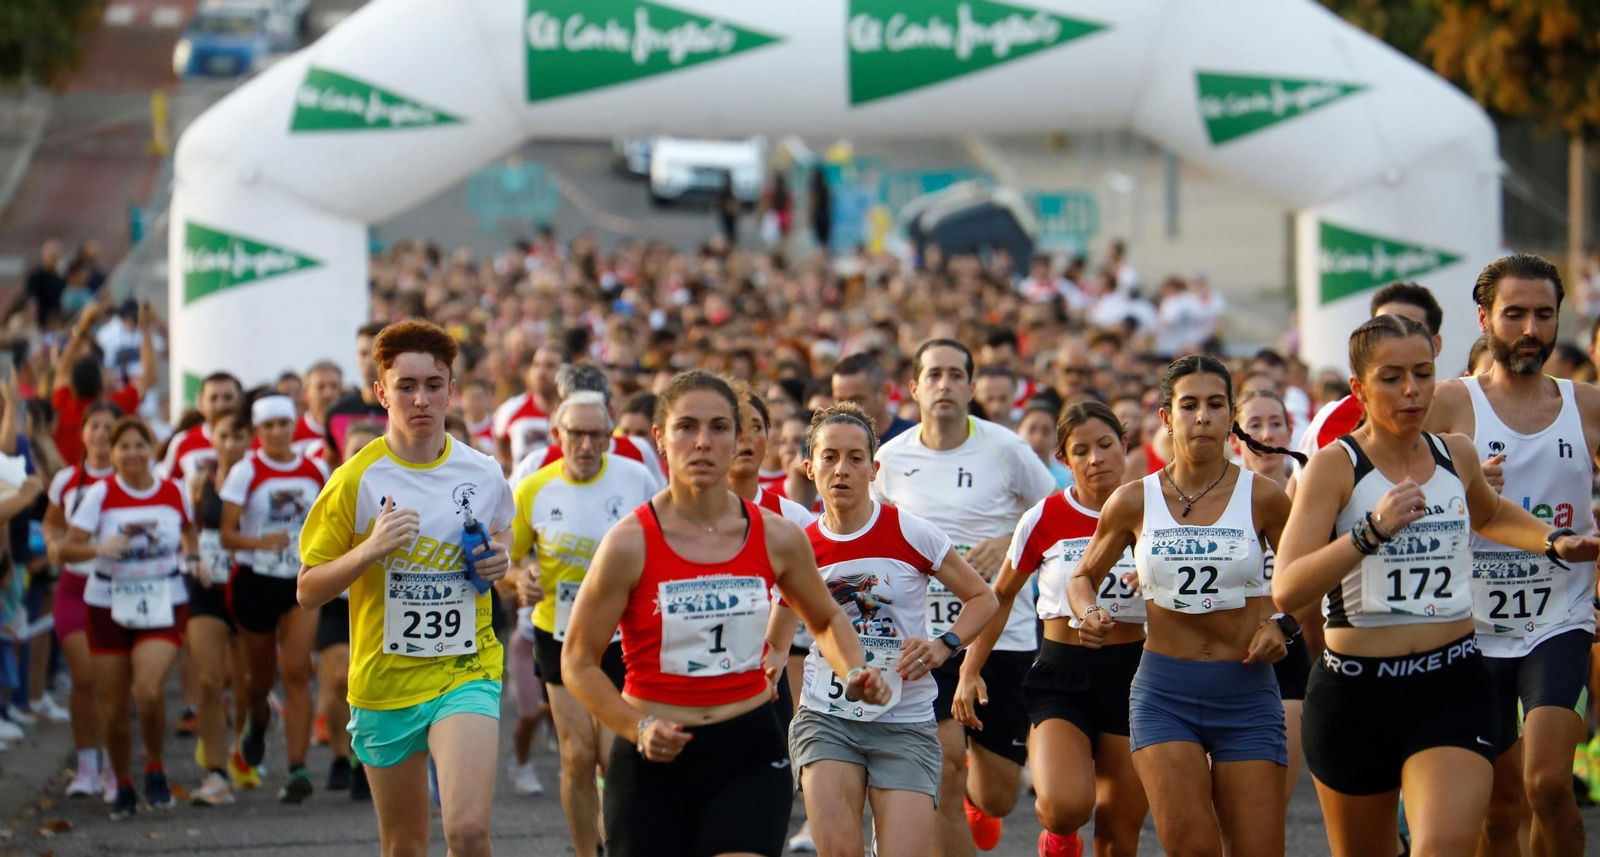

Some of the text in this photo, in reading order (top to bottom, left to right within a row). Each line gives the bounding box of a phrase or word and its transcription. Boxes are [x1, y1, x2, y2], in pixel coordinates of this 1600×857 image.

[389, 583, 425, 592] 2024
[1100, 573, 1135, 599] 29
[1178, 566, 1219, 595] 22
[1387, 566, 1452, 601] 172
[136, 598, 147, 615] 4
[930, 601, 962, 624] 18
[1488, 587, 1551, 619] 217
[403, 609, 461, 639] 239
[709, 624, 726, 654] 1
[1323, 648, 1363, 676] PRO
[1377, 651, 1443, 677] NIKE
